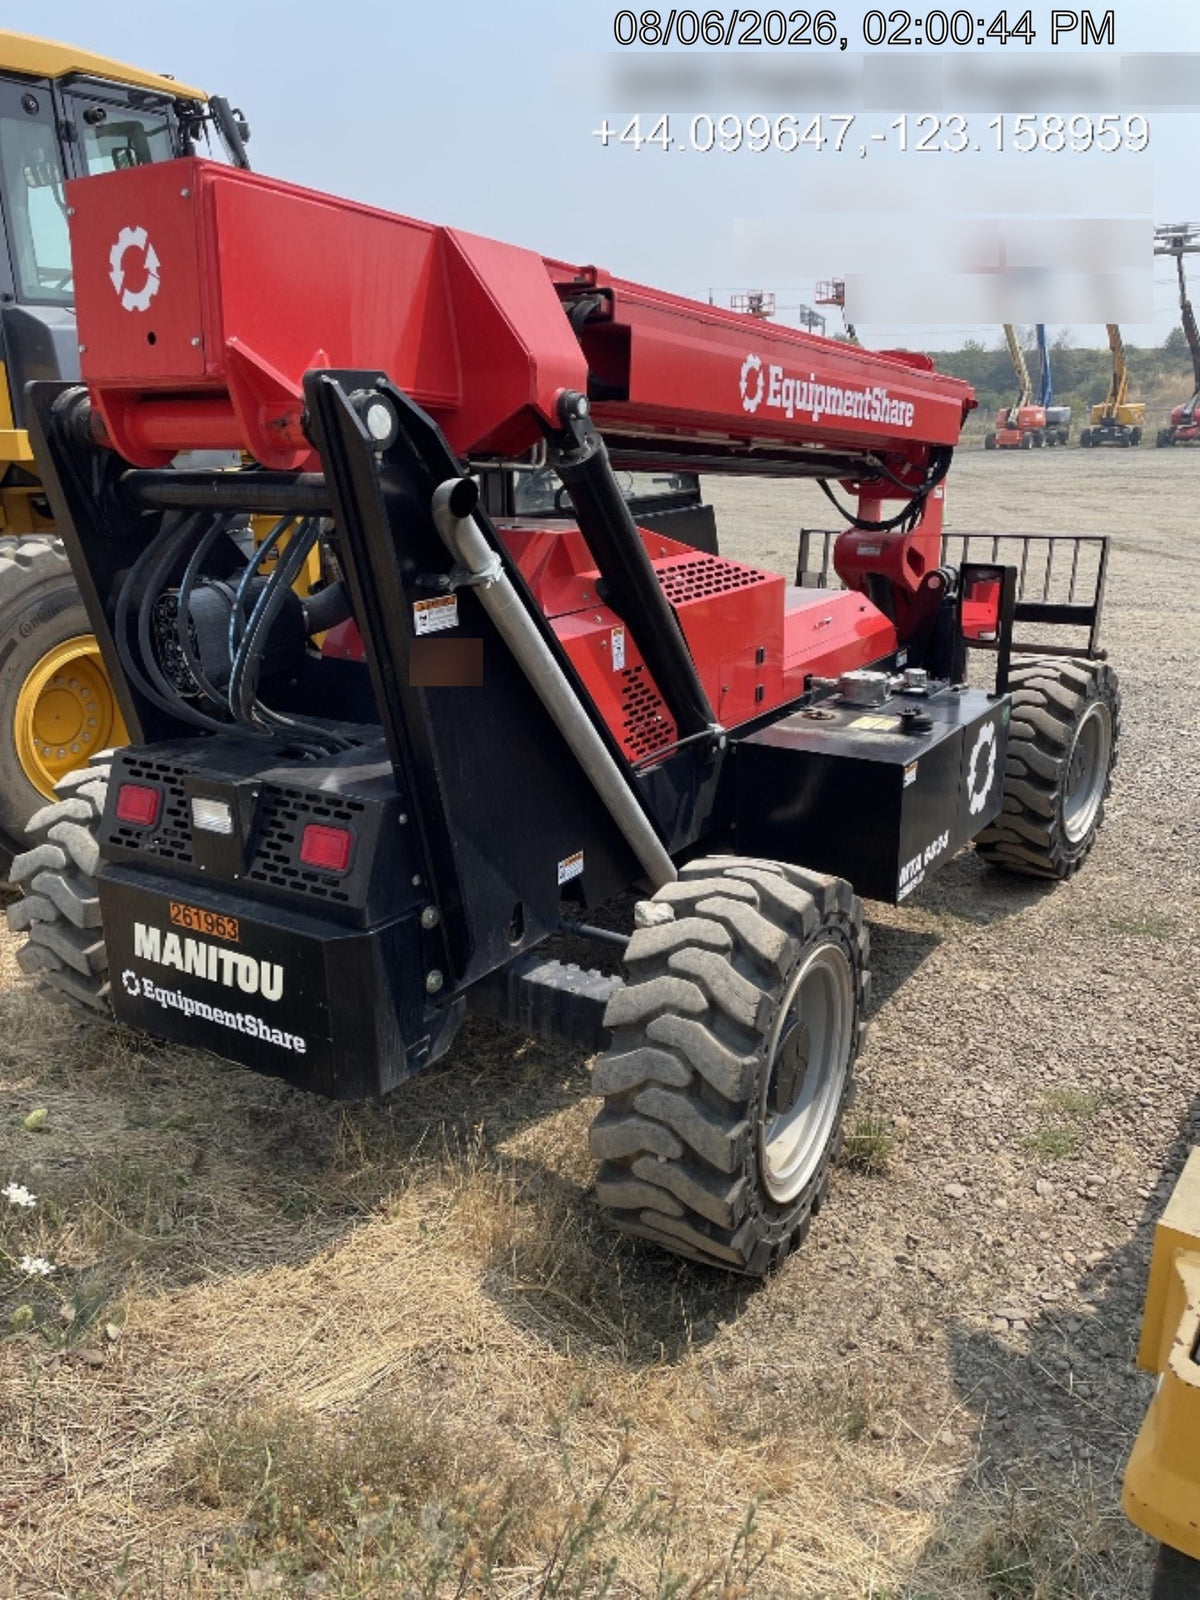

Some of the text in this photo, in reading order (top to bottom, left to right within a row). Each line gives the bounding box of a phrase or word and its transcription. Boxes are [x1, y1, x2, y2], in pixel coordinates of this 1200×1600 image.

[766, 364, 915, 428] EquipmentShare
[171, 904, 238, 940] 261963
[134, 922, 284, 1002] MANITOU
[141, 977, 307, 1053] EquipmentShare
